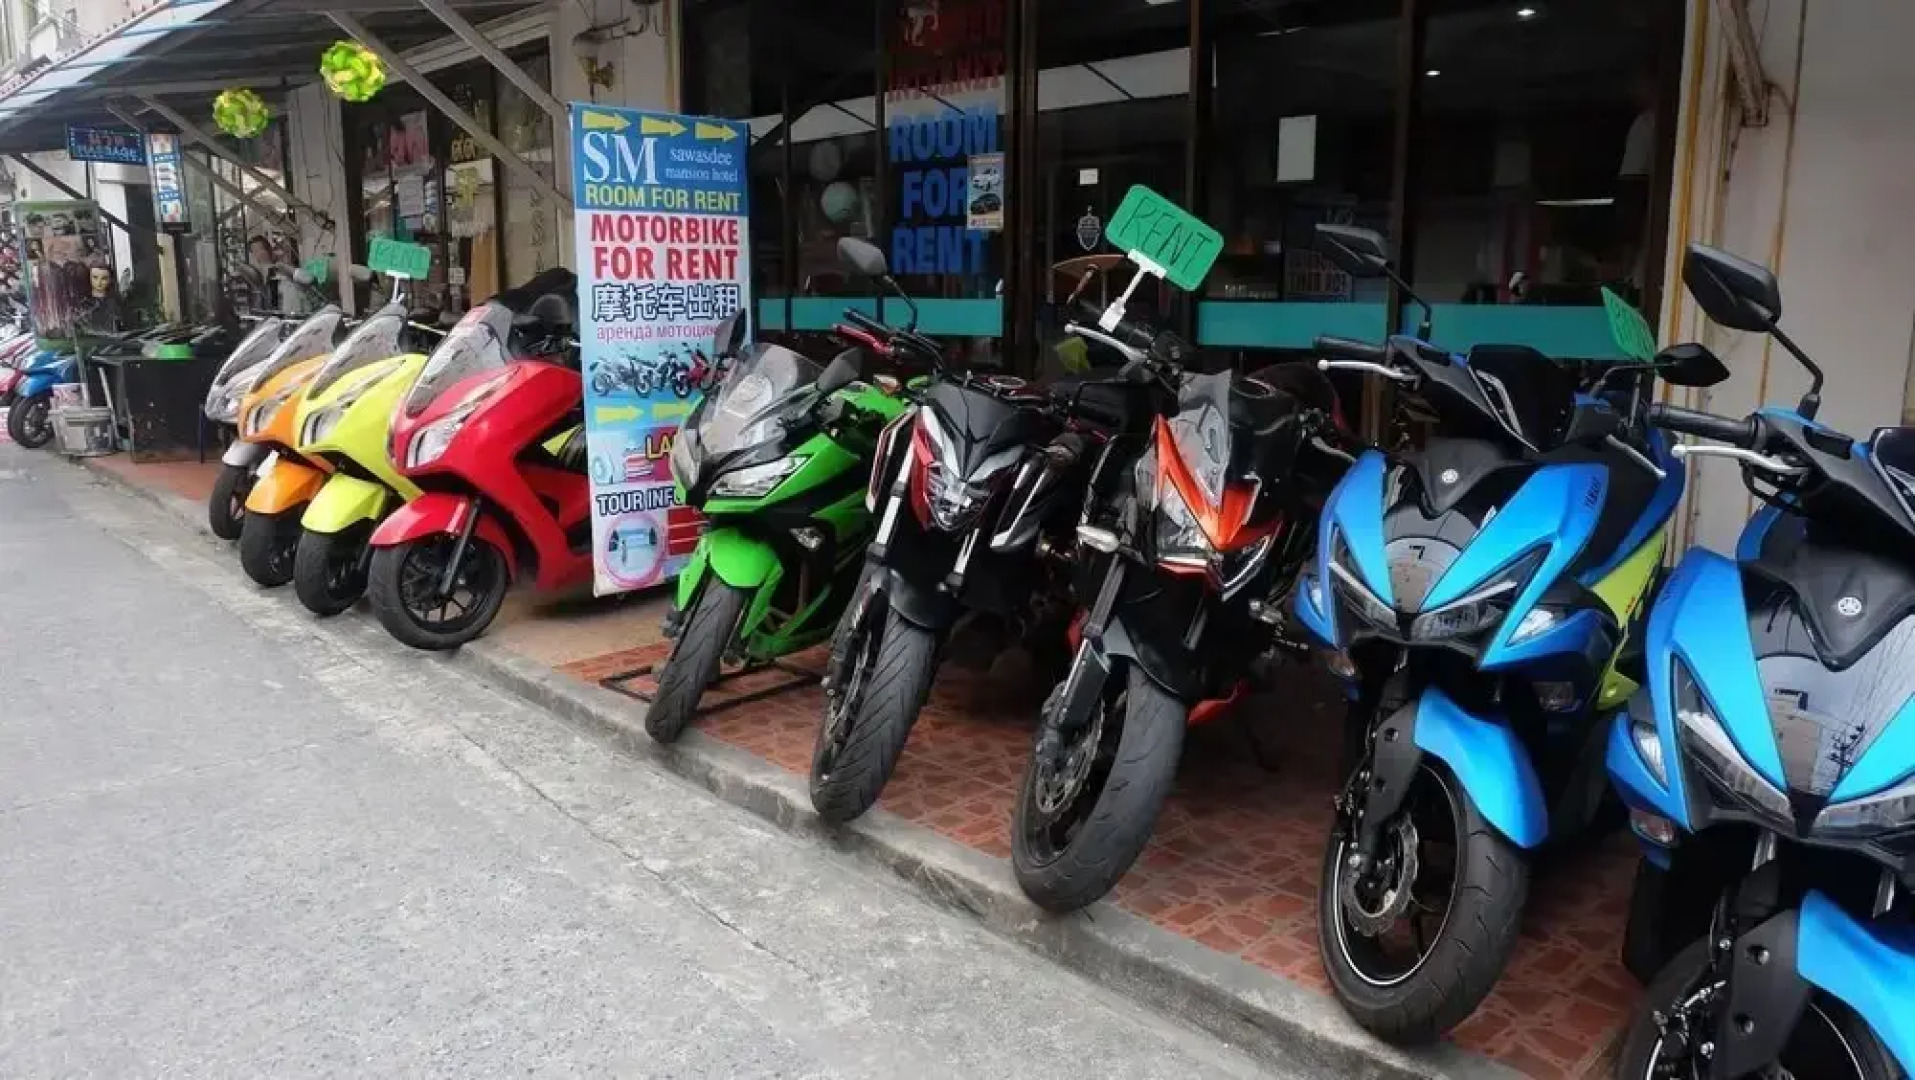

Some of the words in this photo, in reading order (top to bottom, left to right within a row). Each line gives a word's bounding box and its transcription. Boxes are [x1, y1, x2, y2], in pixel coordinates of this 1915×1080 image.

[891, 102, 996, 161] ROOM
[583, 132, 660, 185] SM
[669, 146, 733, 166] sawasdee
[665, 168, 709, 181] mansion
[712, 168, 738, 182] hotel
[585, 184, 645, 208] ROOM
[652, 188, 689, 209] FOR
[694, 191, 741, 212] RENT
[591, 214, 738, 245] MOTORBIKE
[1118, 195, 1212, 274] RENT
[594, 247, 655, 279] FOR
[667, 249, 738, 280] RENT
[892, 225, 984, 274] RENT
[592, 283, 739, 322] 摩托车出租
[597, 324, 651, 345] аренда
[596, 490, 644, 517] TOUR
